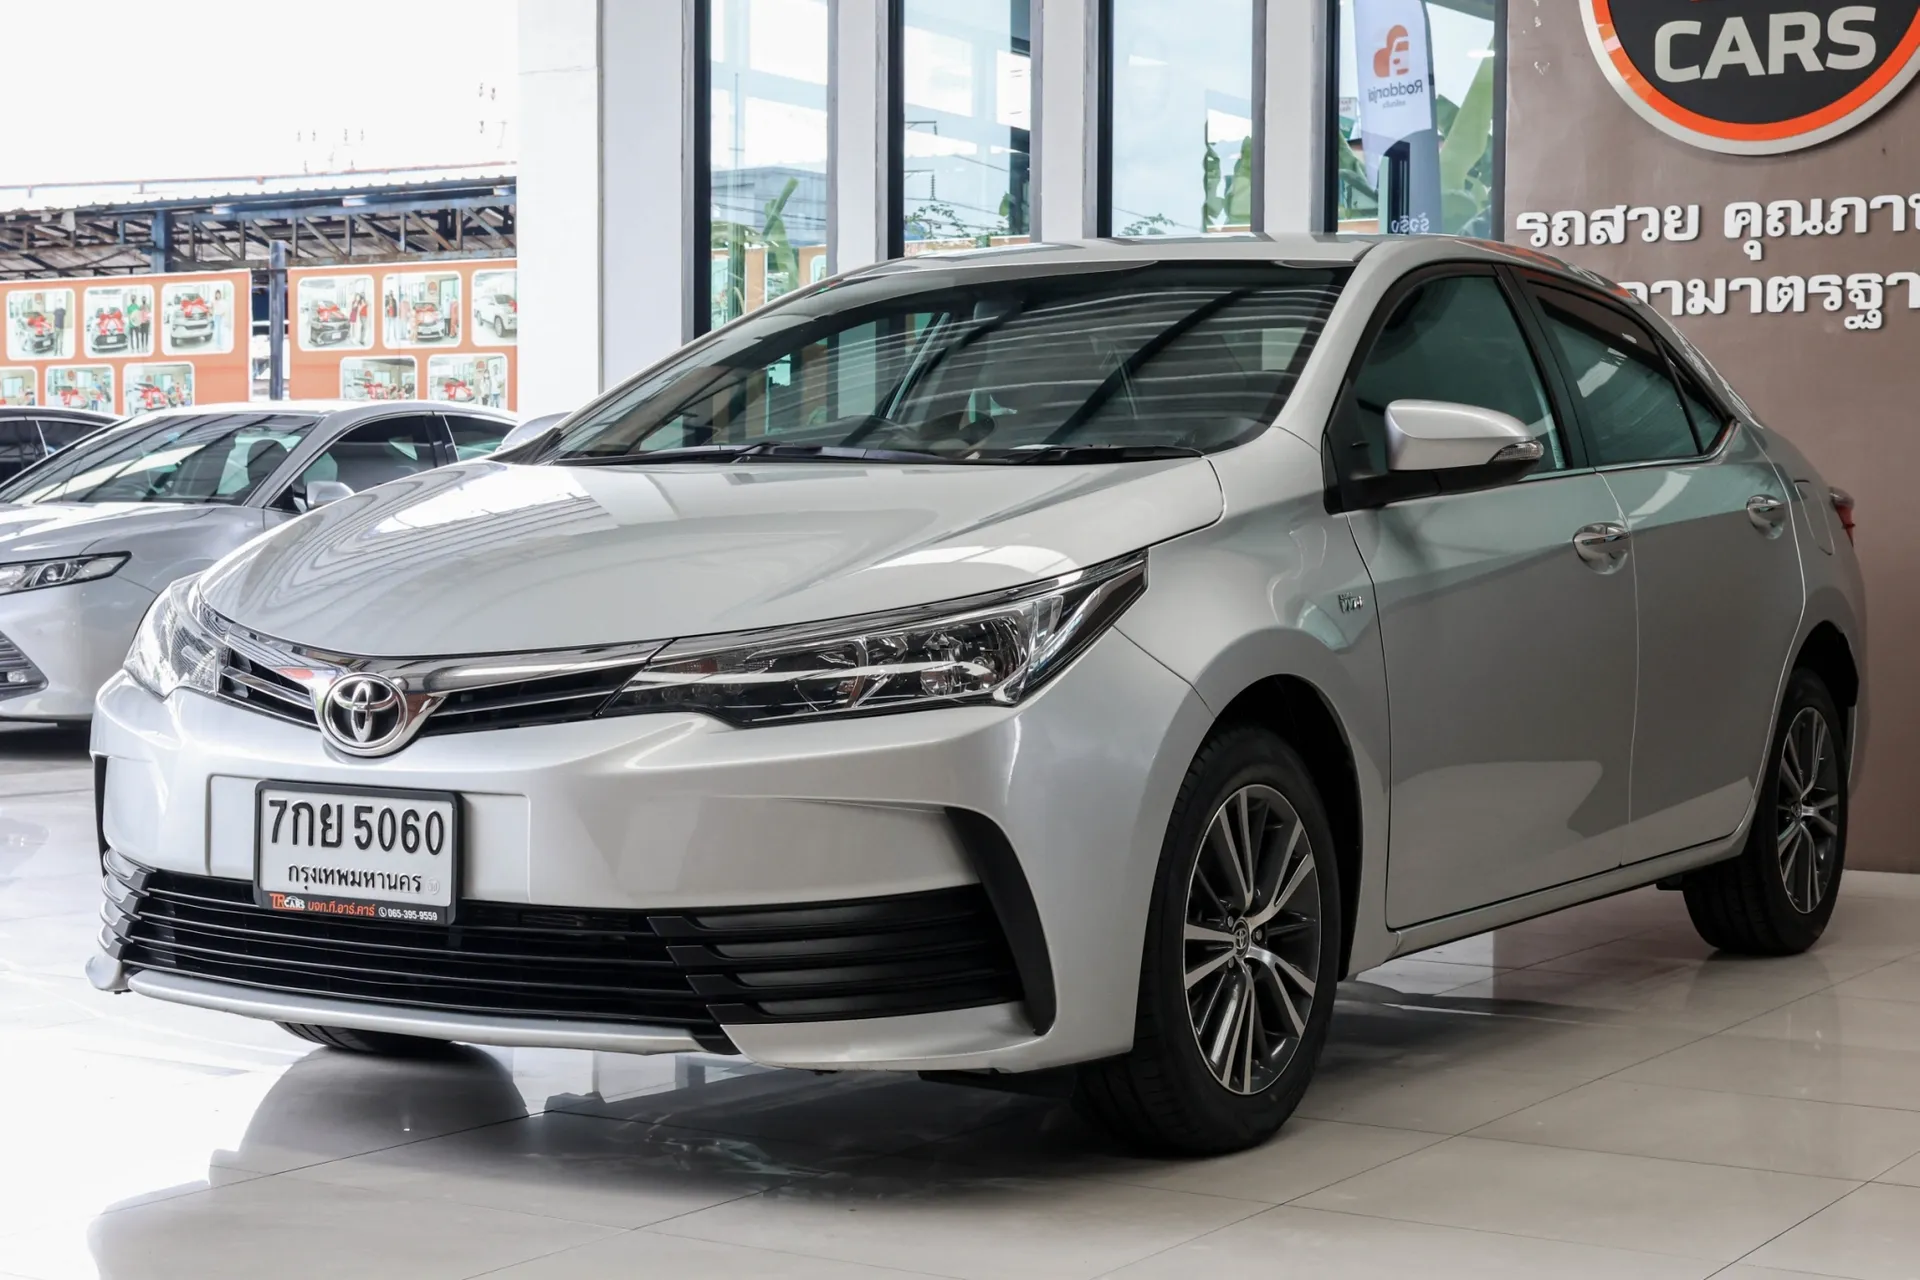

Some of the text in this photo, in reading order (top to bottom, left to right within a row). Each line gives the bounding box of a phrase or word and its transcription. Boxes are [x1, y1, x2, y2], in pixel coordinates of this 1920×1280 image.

[1654, 5, 1877, 83] CARS
[1516, 204, 1700, 248] รถสวย
[268, 799, 445, 856] 7กย 5060
[288, 864, 422, 893] กรุงเทพมหานคร
[388, 907, 438, 921] 065-395-9559
